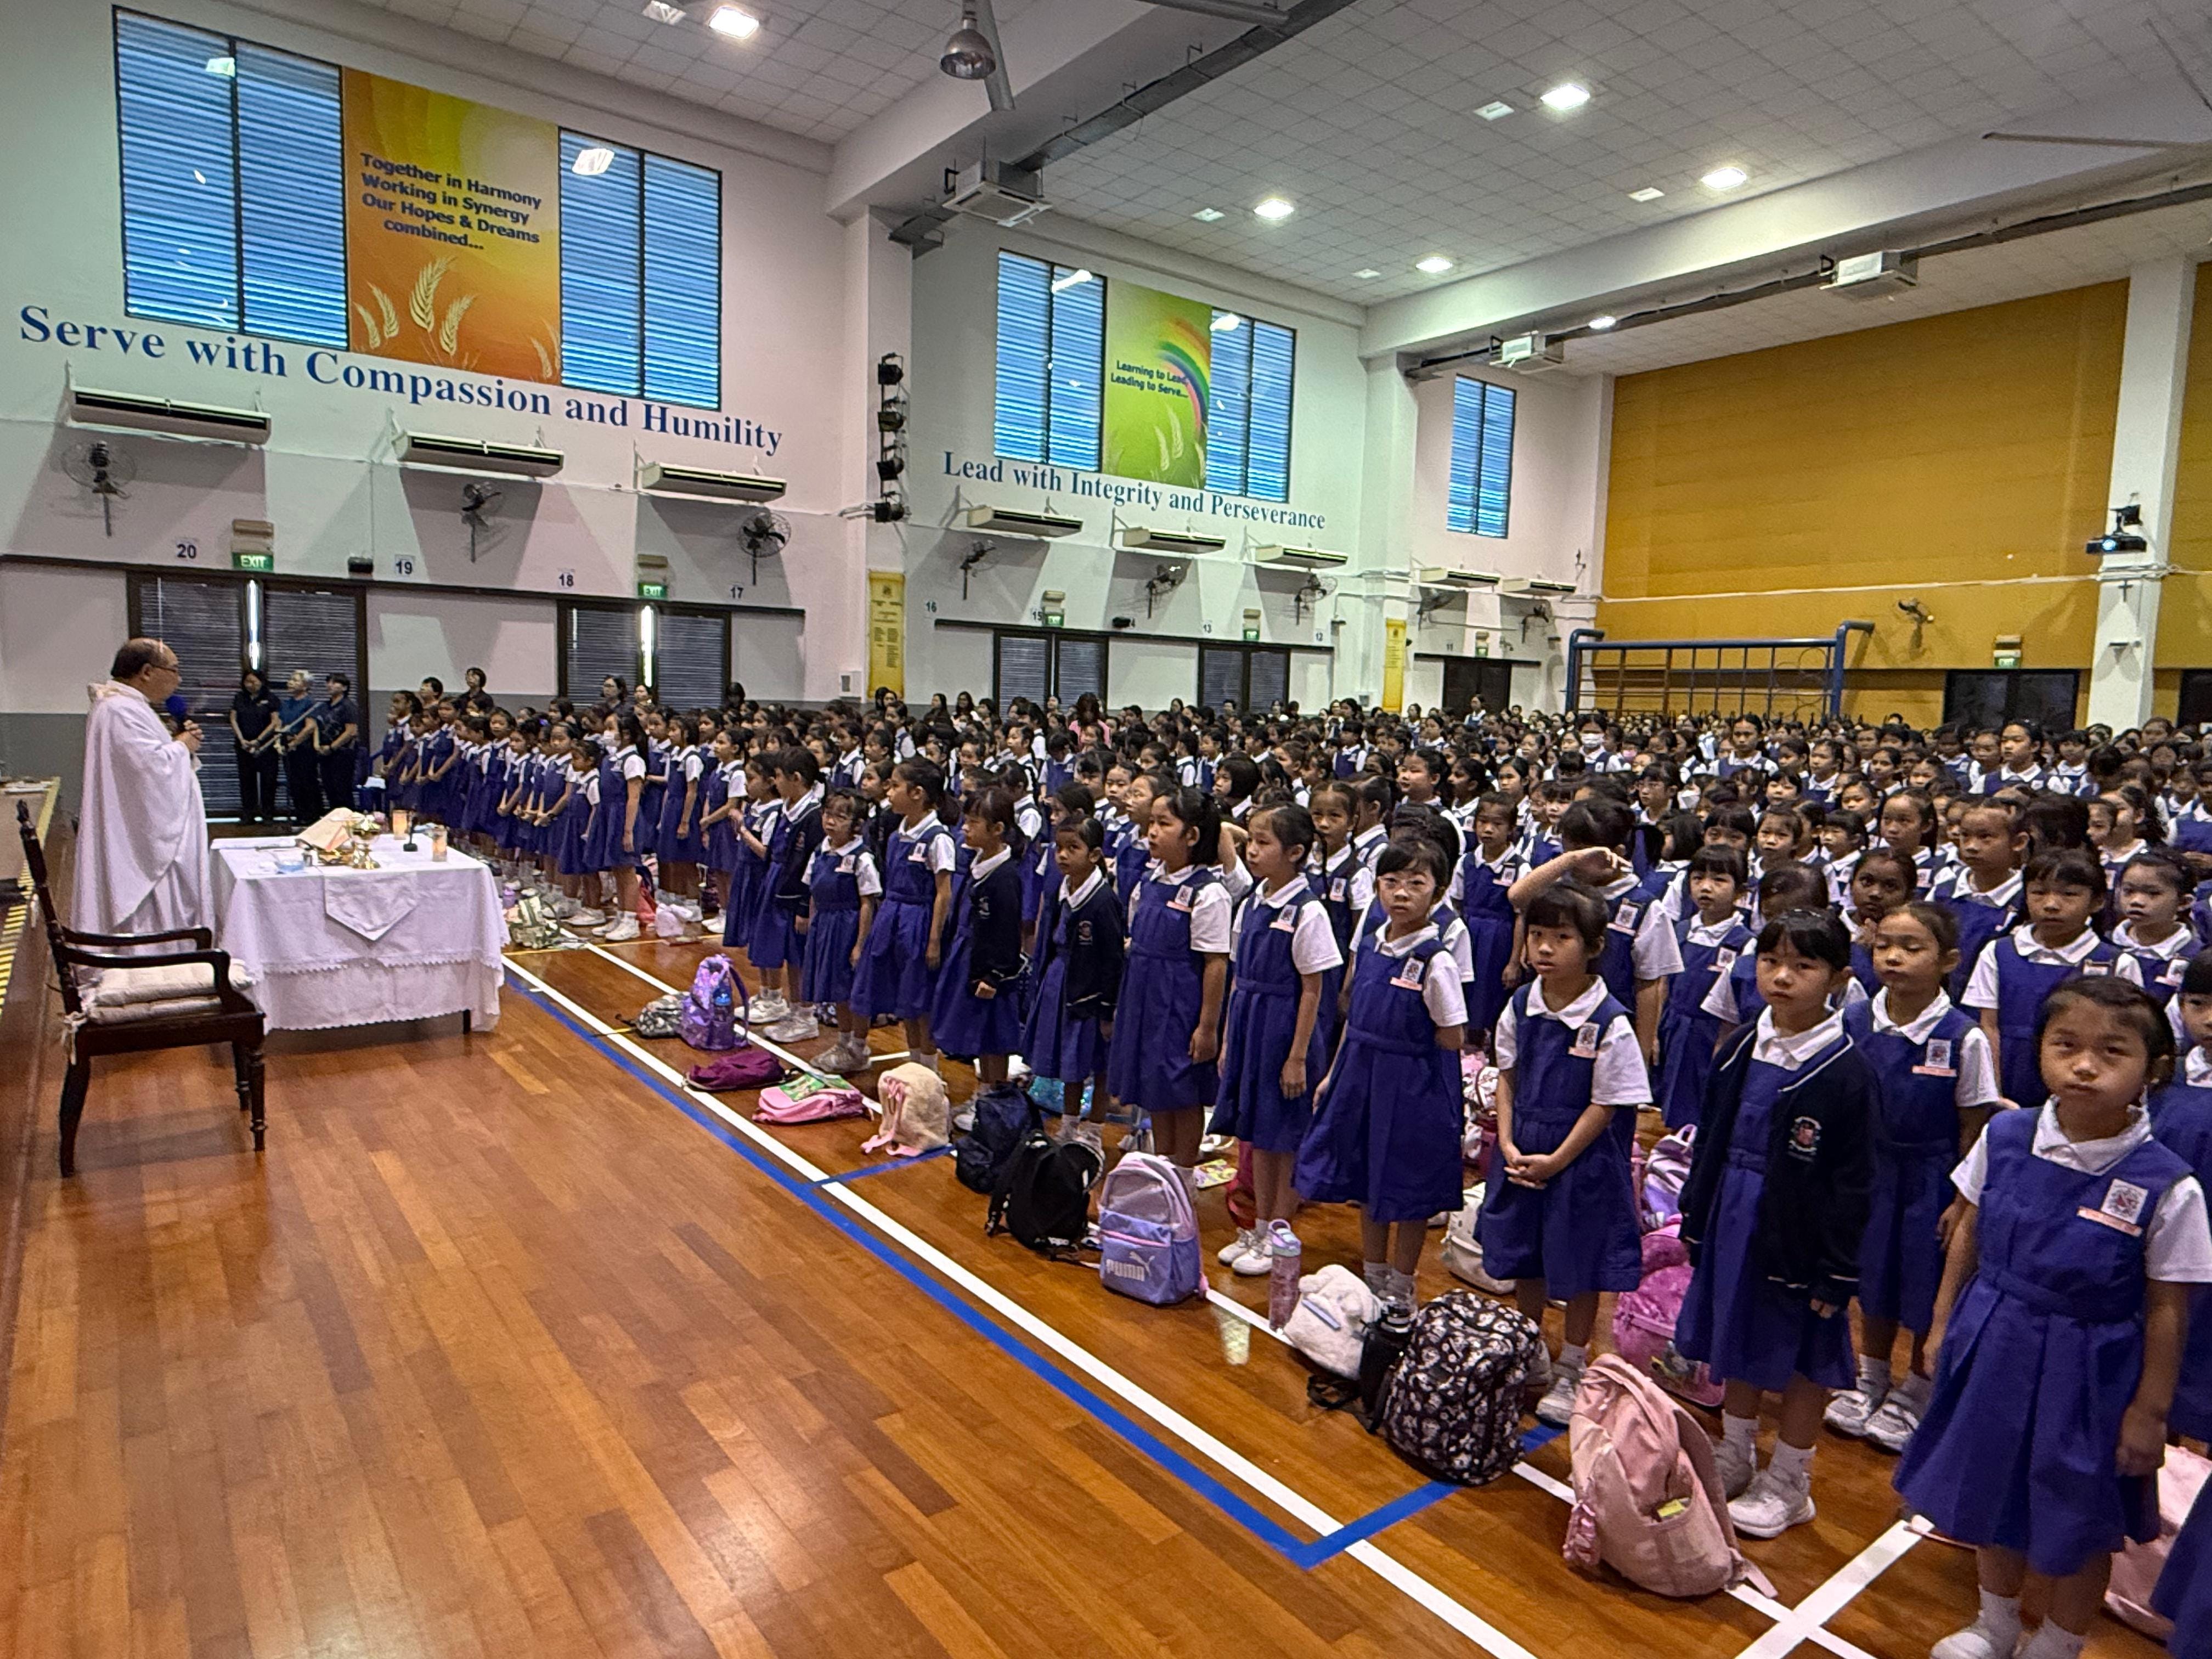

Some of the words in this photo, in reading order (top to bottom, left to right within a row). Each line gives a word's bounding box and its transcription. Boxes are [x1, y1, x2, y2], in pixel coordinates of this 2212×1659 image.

[360, 153, 442, 183] Together
[446, 173, 462, 189] in
[467, 179, 542, 210] Harmony
[361, 172, 437, 205] Working
[442, 191, 458, 206] in
[462, 198, 529, 225] Synergy
[362, 193, 396, 211] Our
[401, 201, 455, 224] Hopes
[460, 215, 472, 228] &
[477, 218, 540, 243] Dreams
[384, 219, 484, 250] combined...
[1116, 360, 1154, 379] Learning
[1156, 369, 1165, 380] to
[20, 306, 166, 358] Serve
[187, 336, 287, 377] with
[306, 351, 551, 415] Compassion
[565, 398, 628, 426] and
[642, 403, 783, 456] Humility
[1111, 373, 1144, 391] Leading
[1147, 381, 1156, 391] to
[944, 451, 1003, 483] Lead
[1013, 464, 1062, 492] with
[1071, 472, 1163, 511] Integrity
[1169, 490, 1204, 513] and
[1211, 495, 1325, 529] Perseverance
[177, 544, 197, 558] 20
[240, 555, 267, 567] EXIT
[395, 560, 413, 576] 19
[559, 574, 574, 587] 18
[643, 585, 663, 597] EXIT
[730, 587, 744, 599] 17
[926, 601, 937, 613] 16
[1106, 1259, 1145, 1282] PUMA
